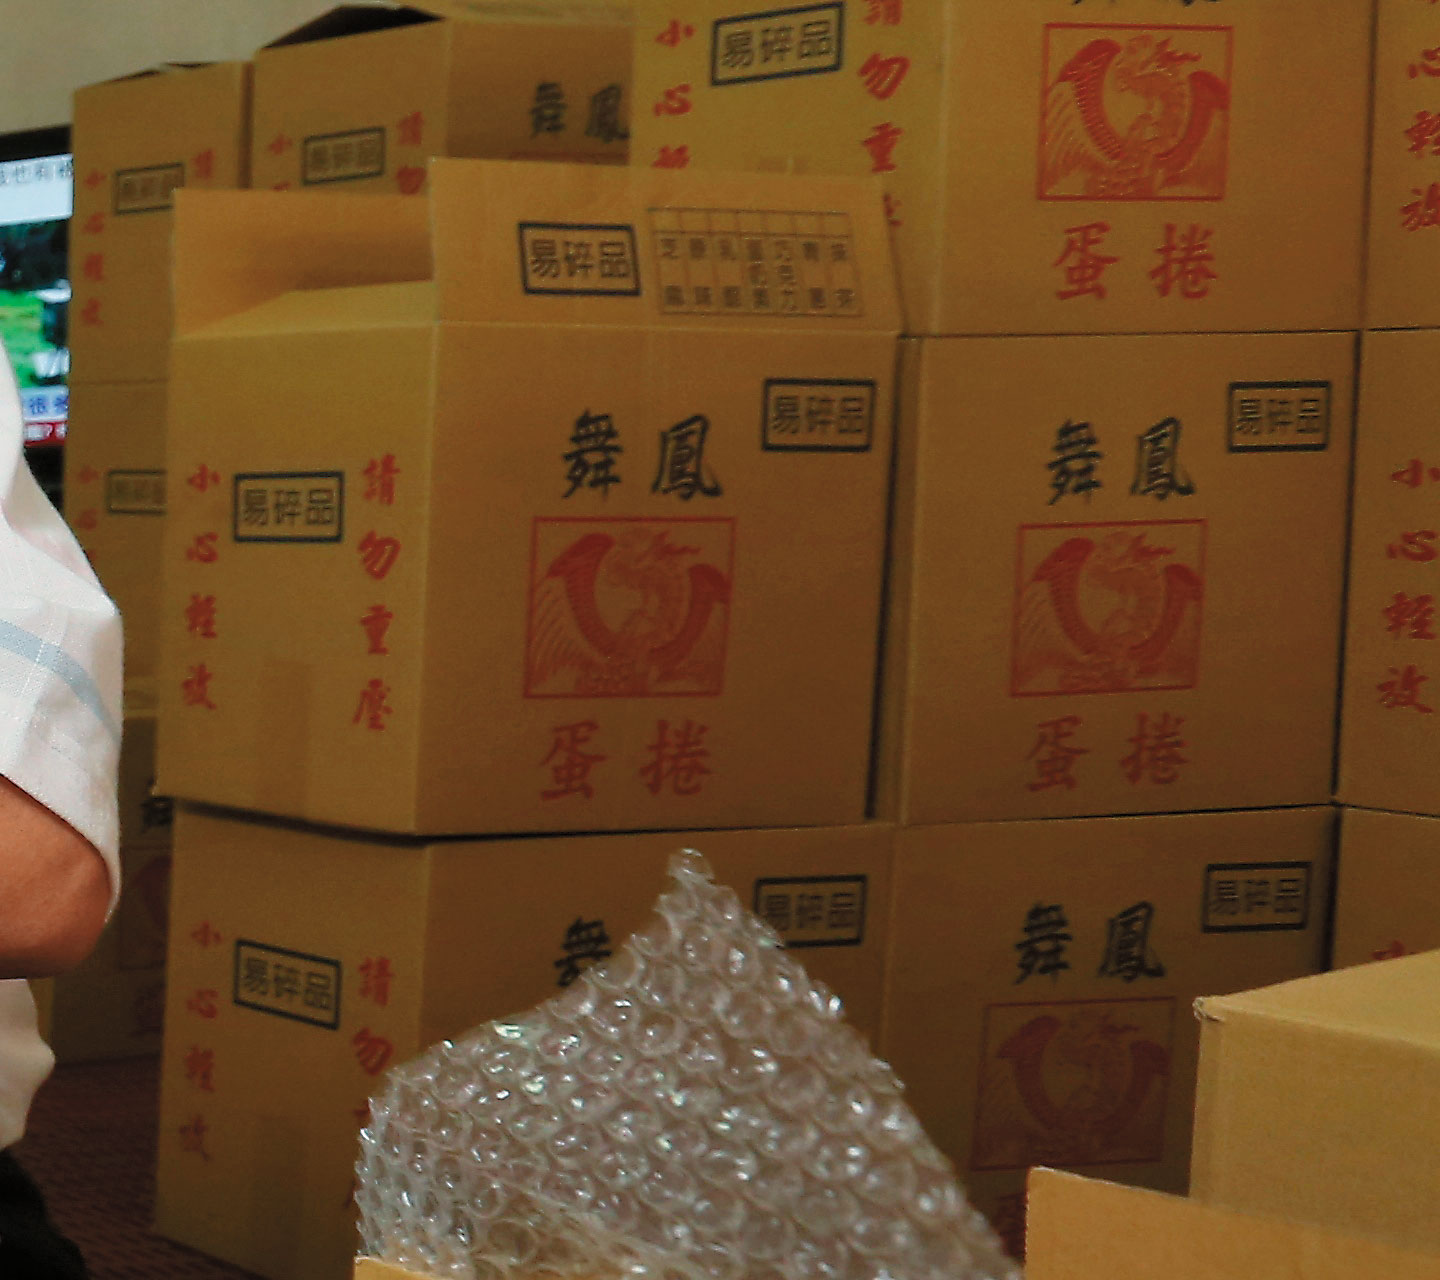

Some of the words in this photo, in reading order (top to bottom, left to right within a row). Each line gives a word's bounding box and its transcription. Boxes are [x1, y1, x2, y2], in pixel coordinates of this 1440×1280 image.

[720, 18, 833, 70] 易碎品
[529, 238, 633, 282] 易碎品
[1052, 220, 1220, 302] 蛋捲
[562, 409, 722, 500] 舞鳳
[772, 393, 866, 436] 易碎品
[1234, 394, 1323, 437] 易碎品
[1047, 416, 1196, 506] 舞鳳
[240, 483, 336, 529] 易碎品
[353, 453, 401, 732] 請勿重壓
[540, 720, 712, 802] 蛋捲
[1026, 713, 1190, 793] 蛋捲
[1011, 901, 1167, 987] 舞鳳
